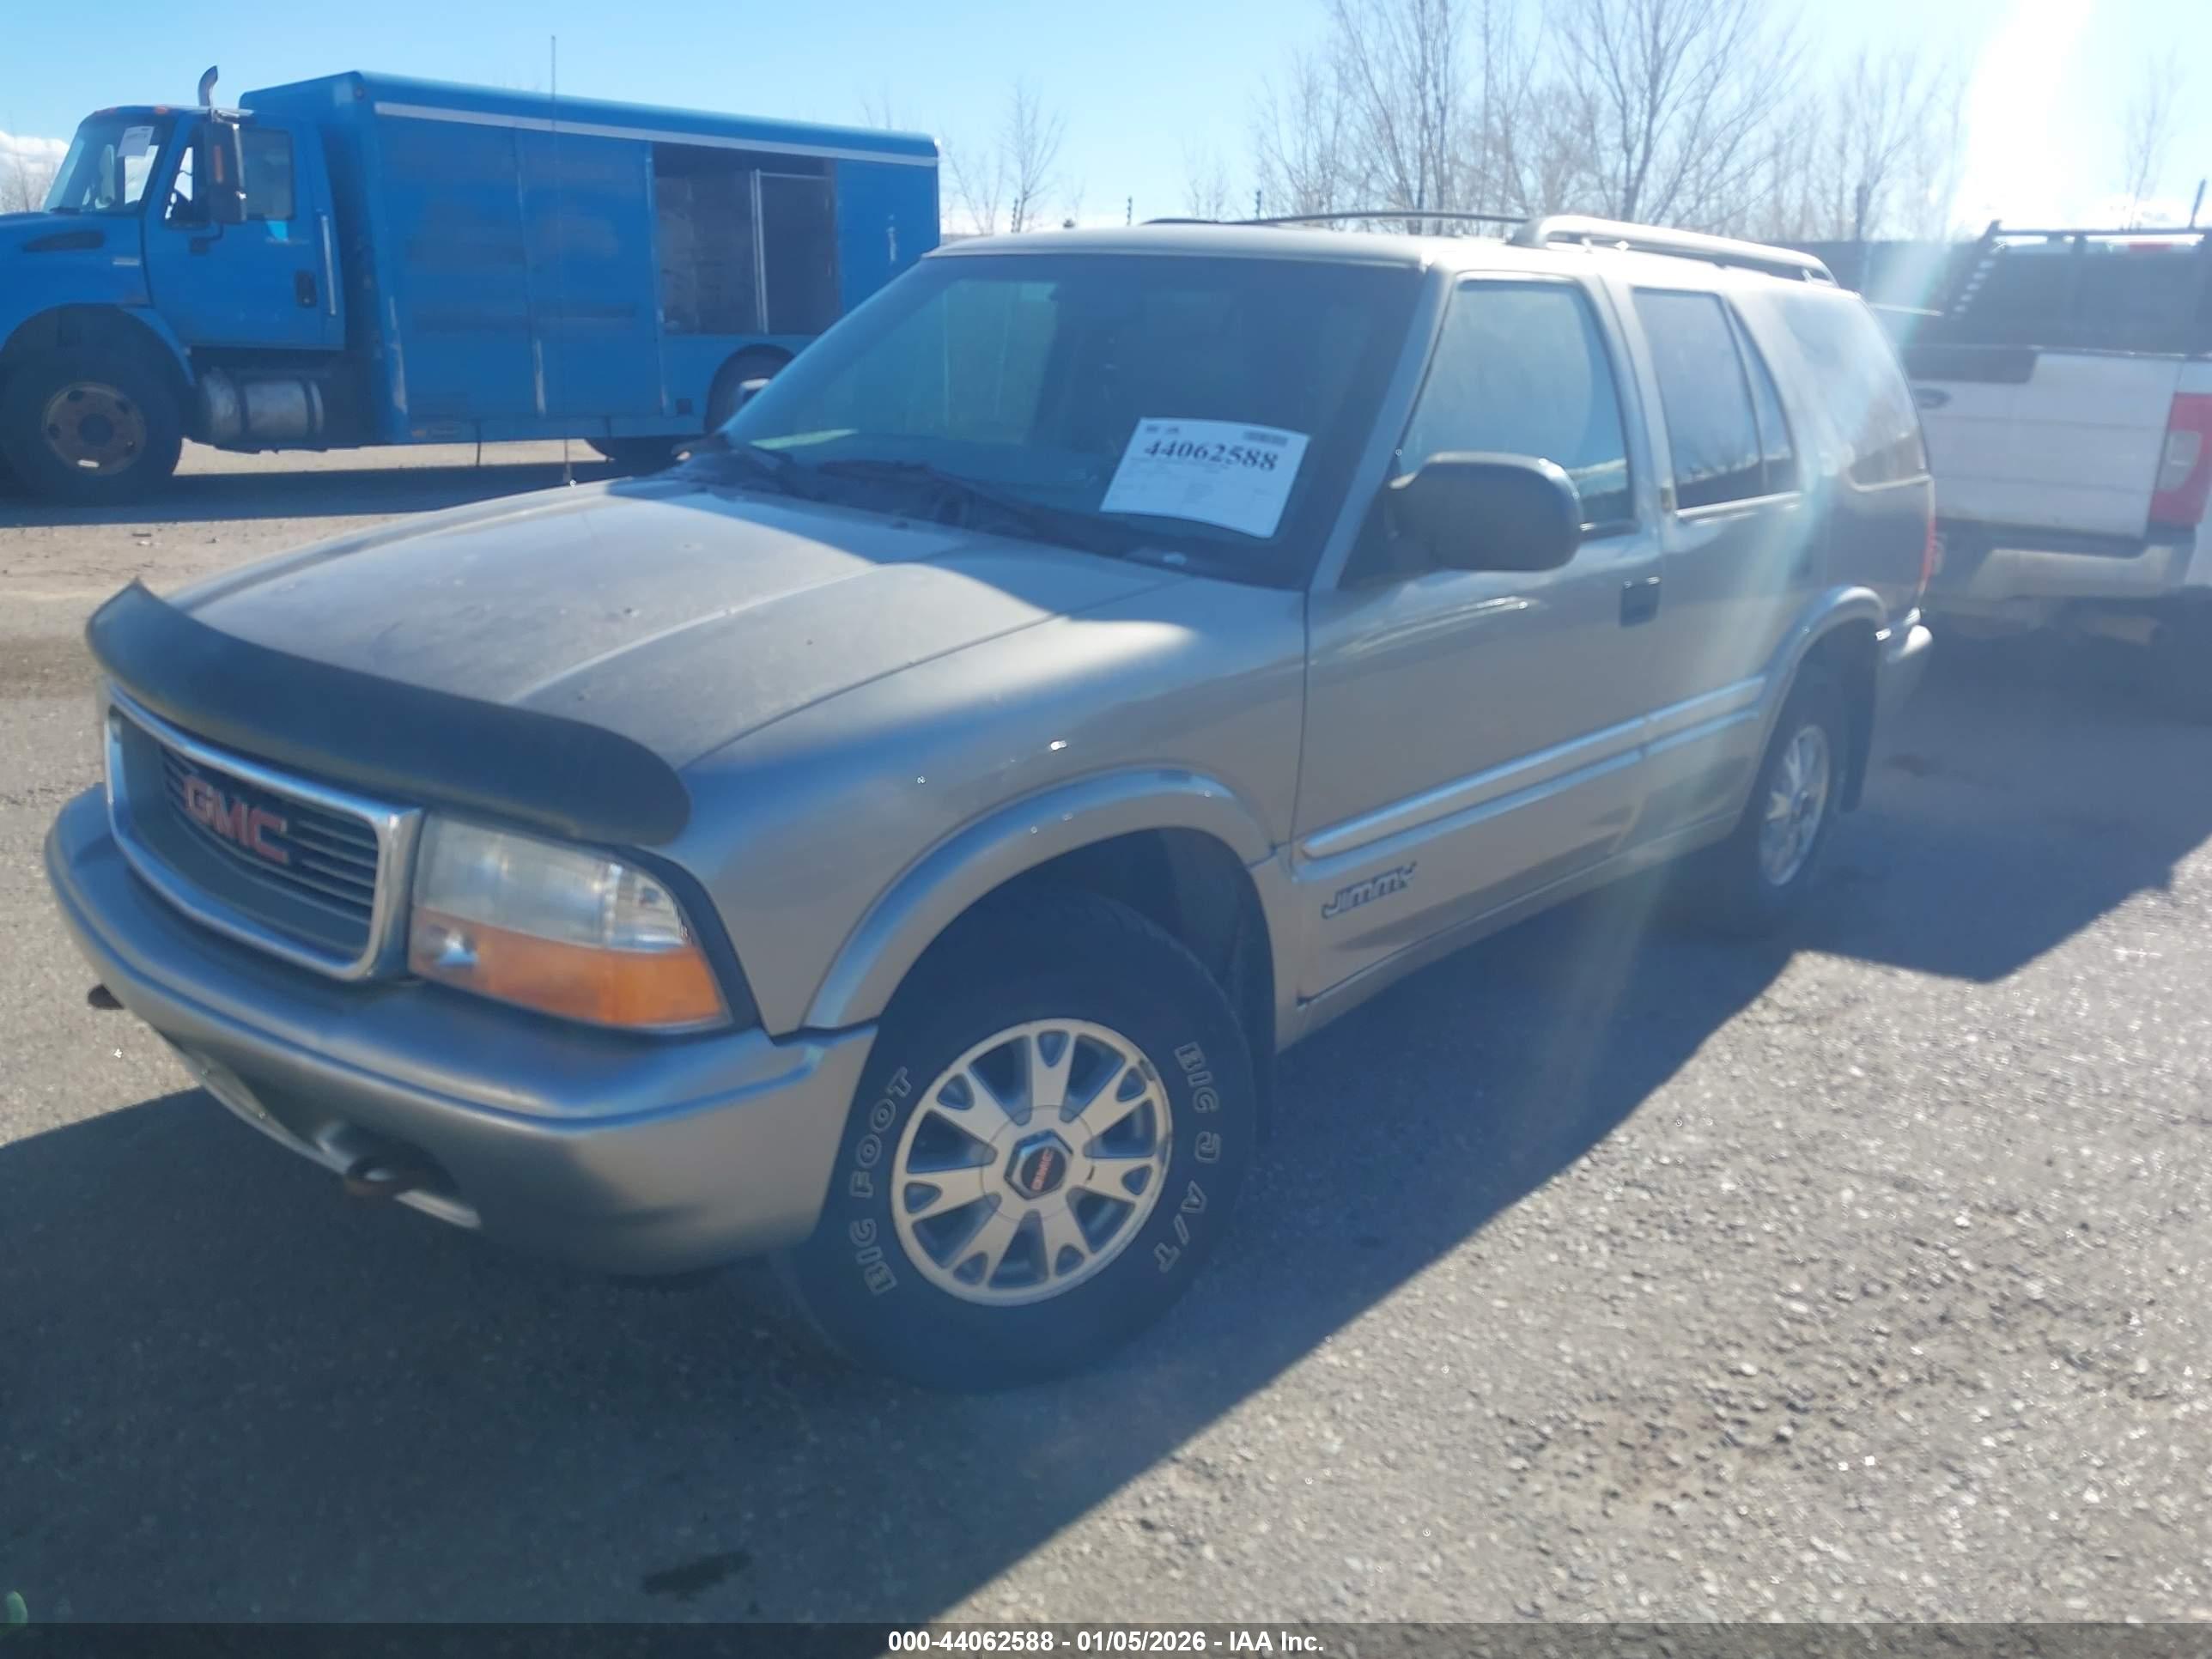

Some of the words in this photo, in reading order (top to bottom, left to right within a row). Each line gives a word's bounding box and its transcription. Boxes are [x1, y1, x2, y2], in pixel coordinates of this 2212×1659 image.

[1146, 441, 1279, 471] 44062588
[182, 775, 289, 863] GMC
[1174, 1042, 1220, 1114] BIG
[850, 1066, 913, 1199] FOOT
[849, 1218, 897, 1296] BIG
[1153, 1180, 1208, 1273] A/T
